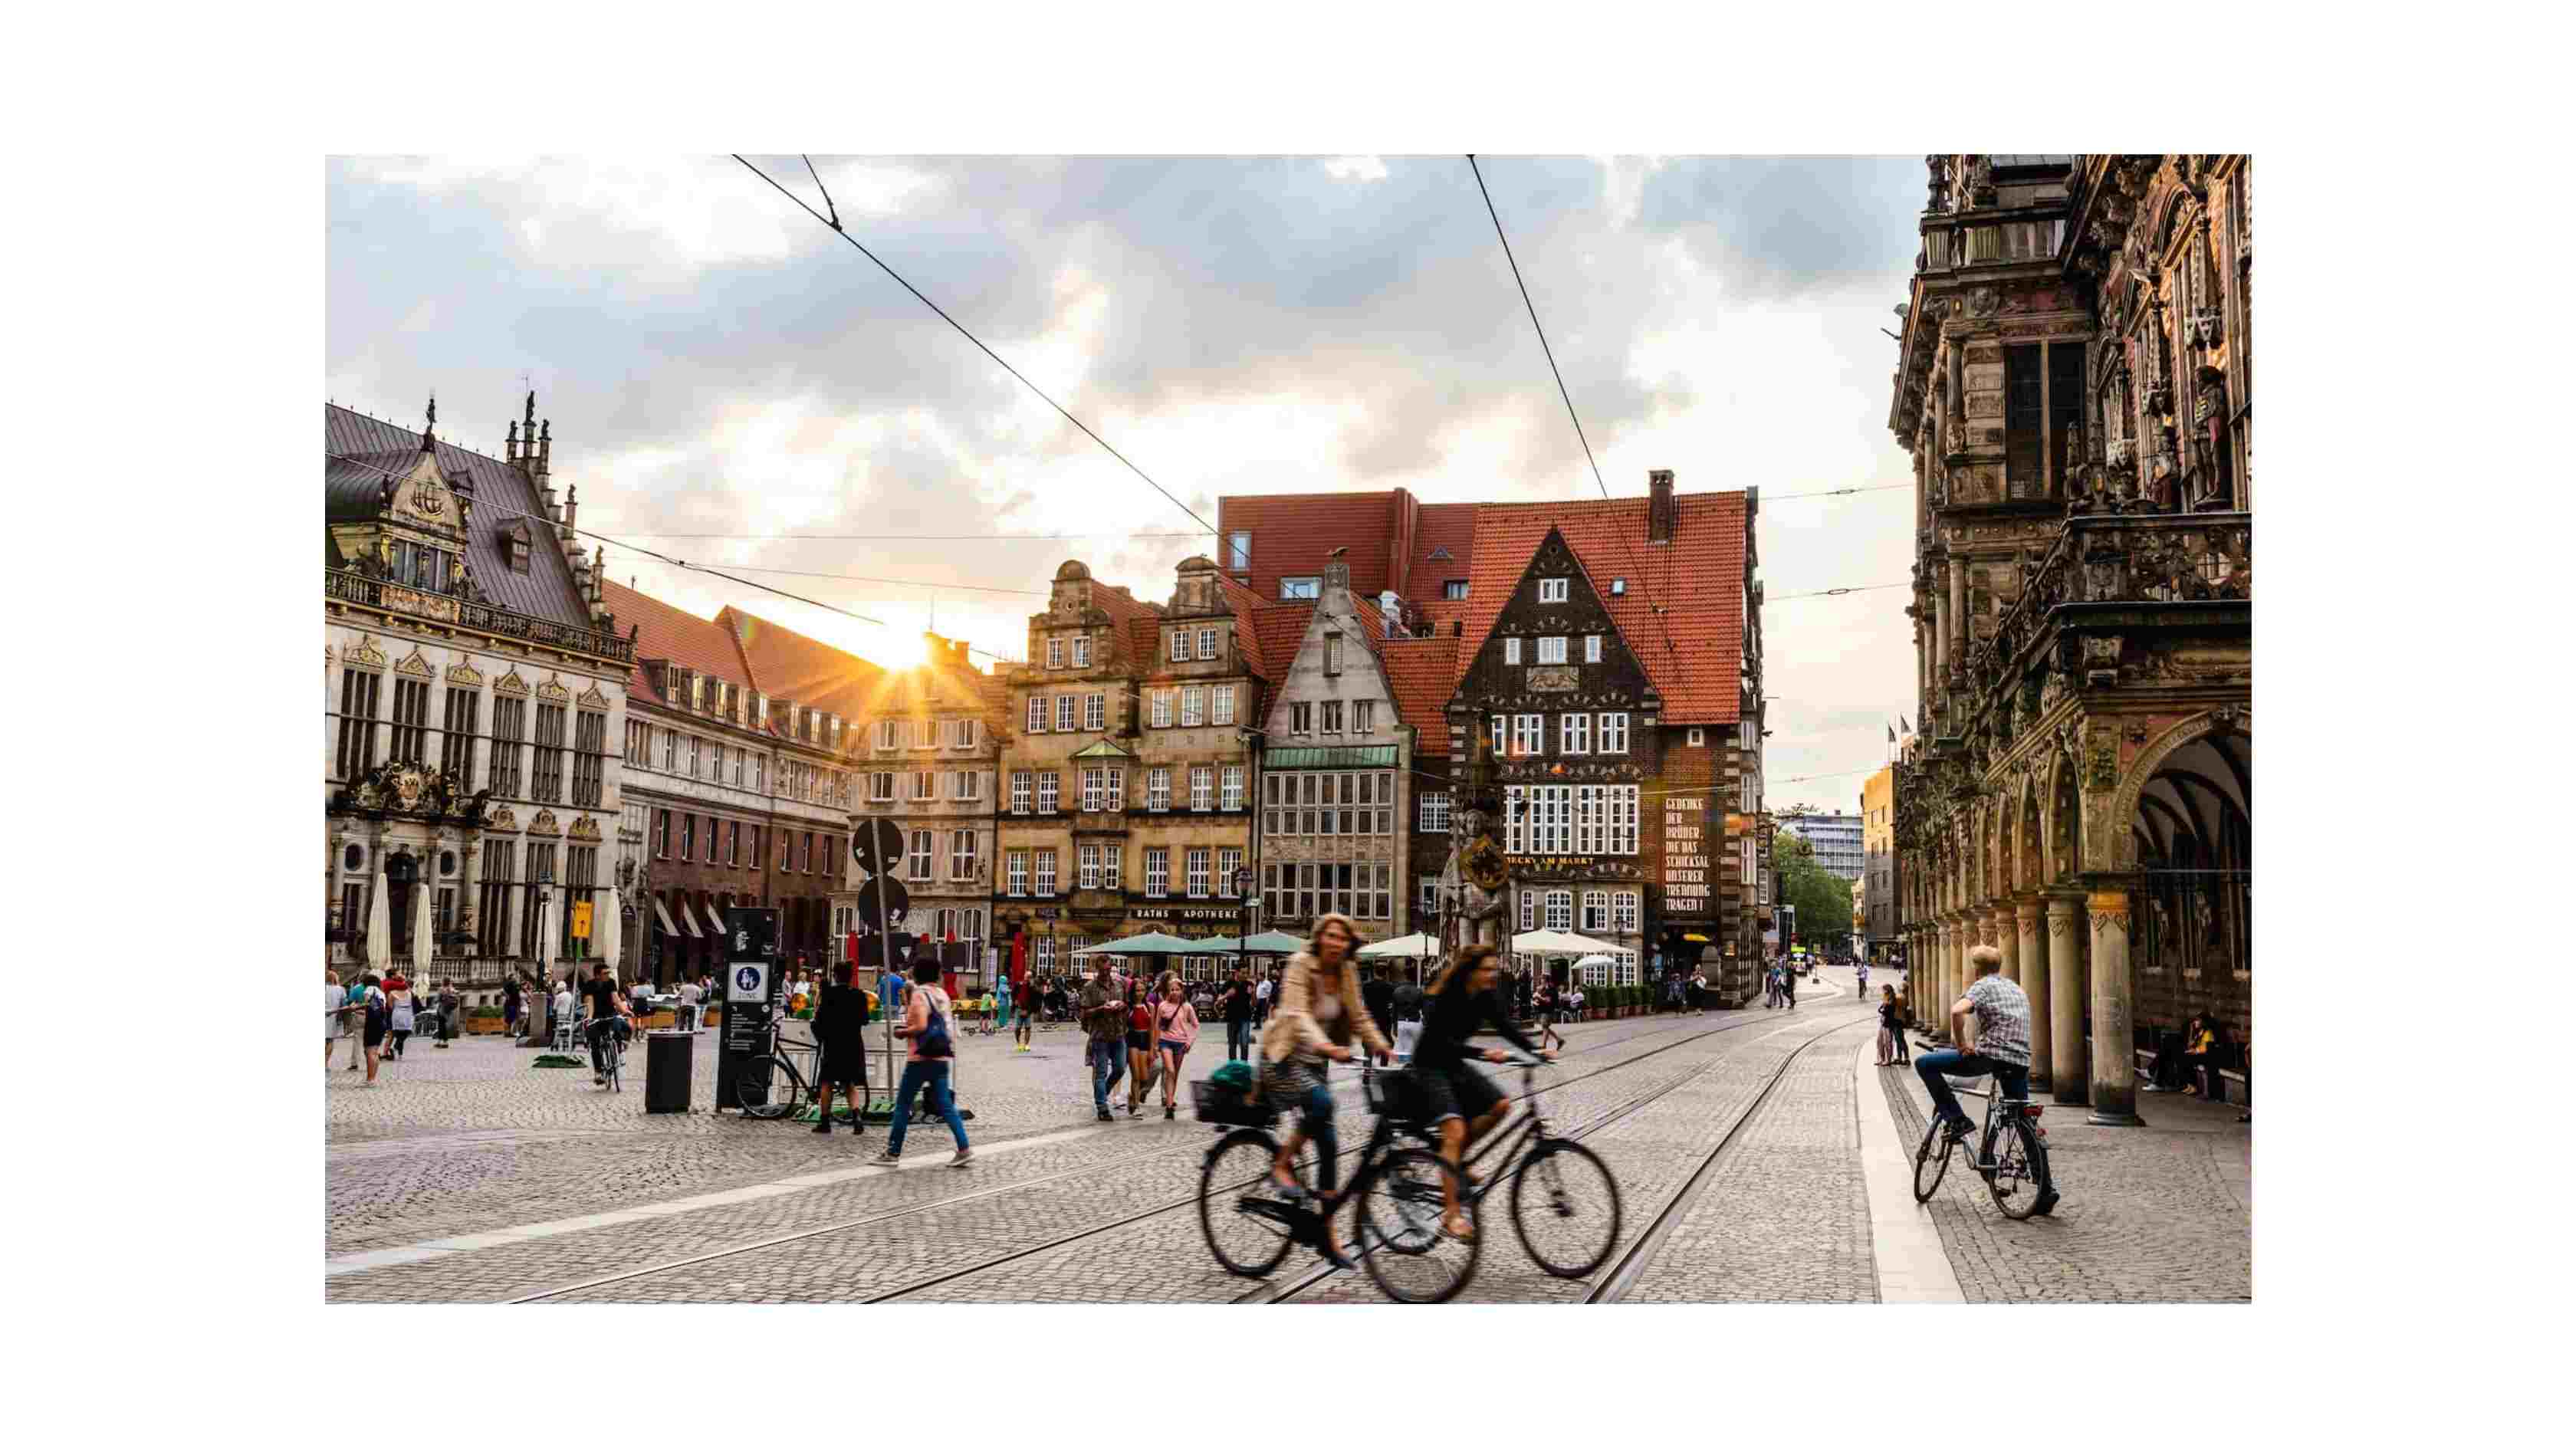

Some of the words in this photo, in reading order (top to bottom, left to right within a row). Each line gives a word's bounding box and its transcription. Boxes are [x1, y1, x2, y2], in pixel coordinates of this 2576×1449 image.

[1665, 797, 1704, 810] GEDENKE
[1665, 812, 1682, 824] DER
[1665, 841, 1681, 853] DIE
[1681, 841, 1699, 853] DAS
[1665, 855, 1710, 868] SCHICKSAL
[1665, 870, 1704, 882] UNSERER
[1664, 884, 1710, 896] TRENNUNG
[1136, 909, 1170, 918] RATHS
[1184, 909, 1240, 919] APOTHEKE
